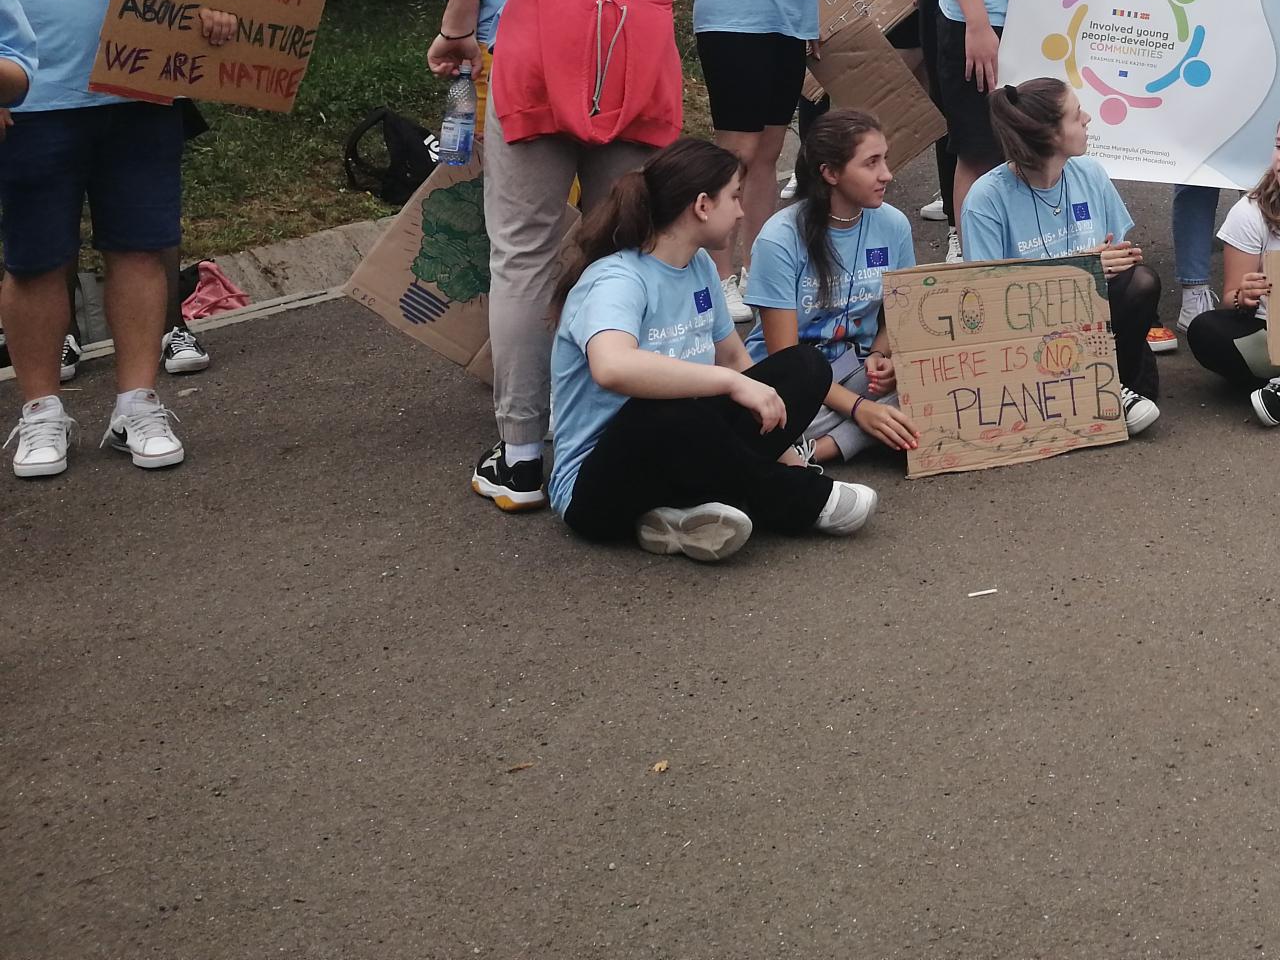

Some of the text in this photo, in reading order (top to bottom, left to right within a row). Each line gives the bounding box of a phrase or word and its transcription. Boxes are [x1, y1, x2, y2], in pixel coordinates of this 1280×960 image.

[236, 17, 318, 60] NATURE
[1081, 31, 1175, 51] people-developed
[1089, 20, 1169, 41] Involved young
[1089, 42, 1165, 60] COMMUNITIES
[105, 40, 305, 99] WE ARE NATURE
[1057, 226, 1068, 239] KA
[917, 278, 1095, 342] GO GREEN
[910, 344, 1073, 387] THERE IS NO
[946, 361, 1121, 430] PLANET B
